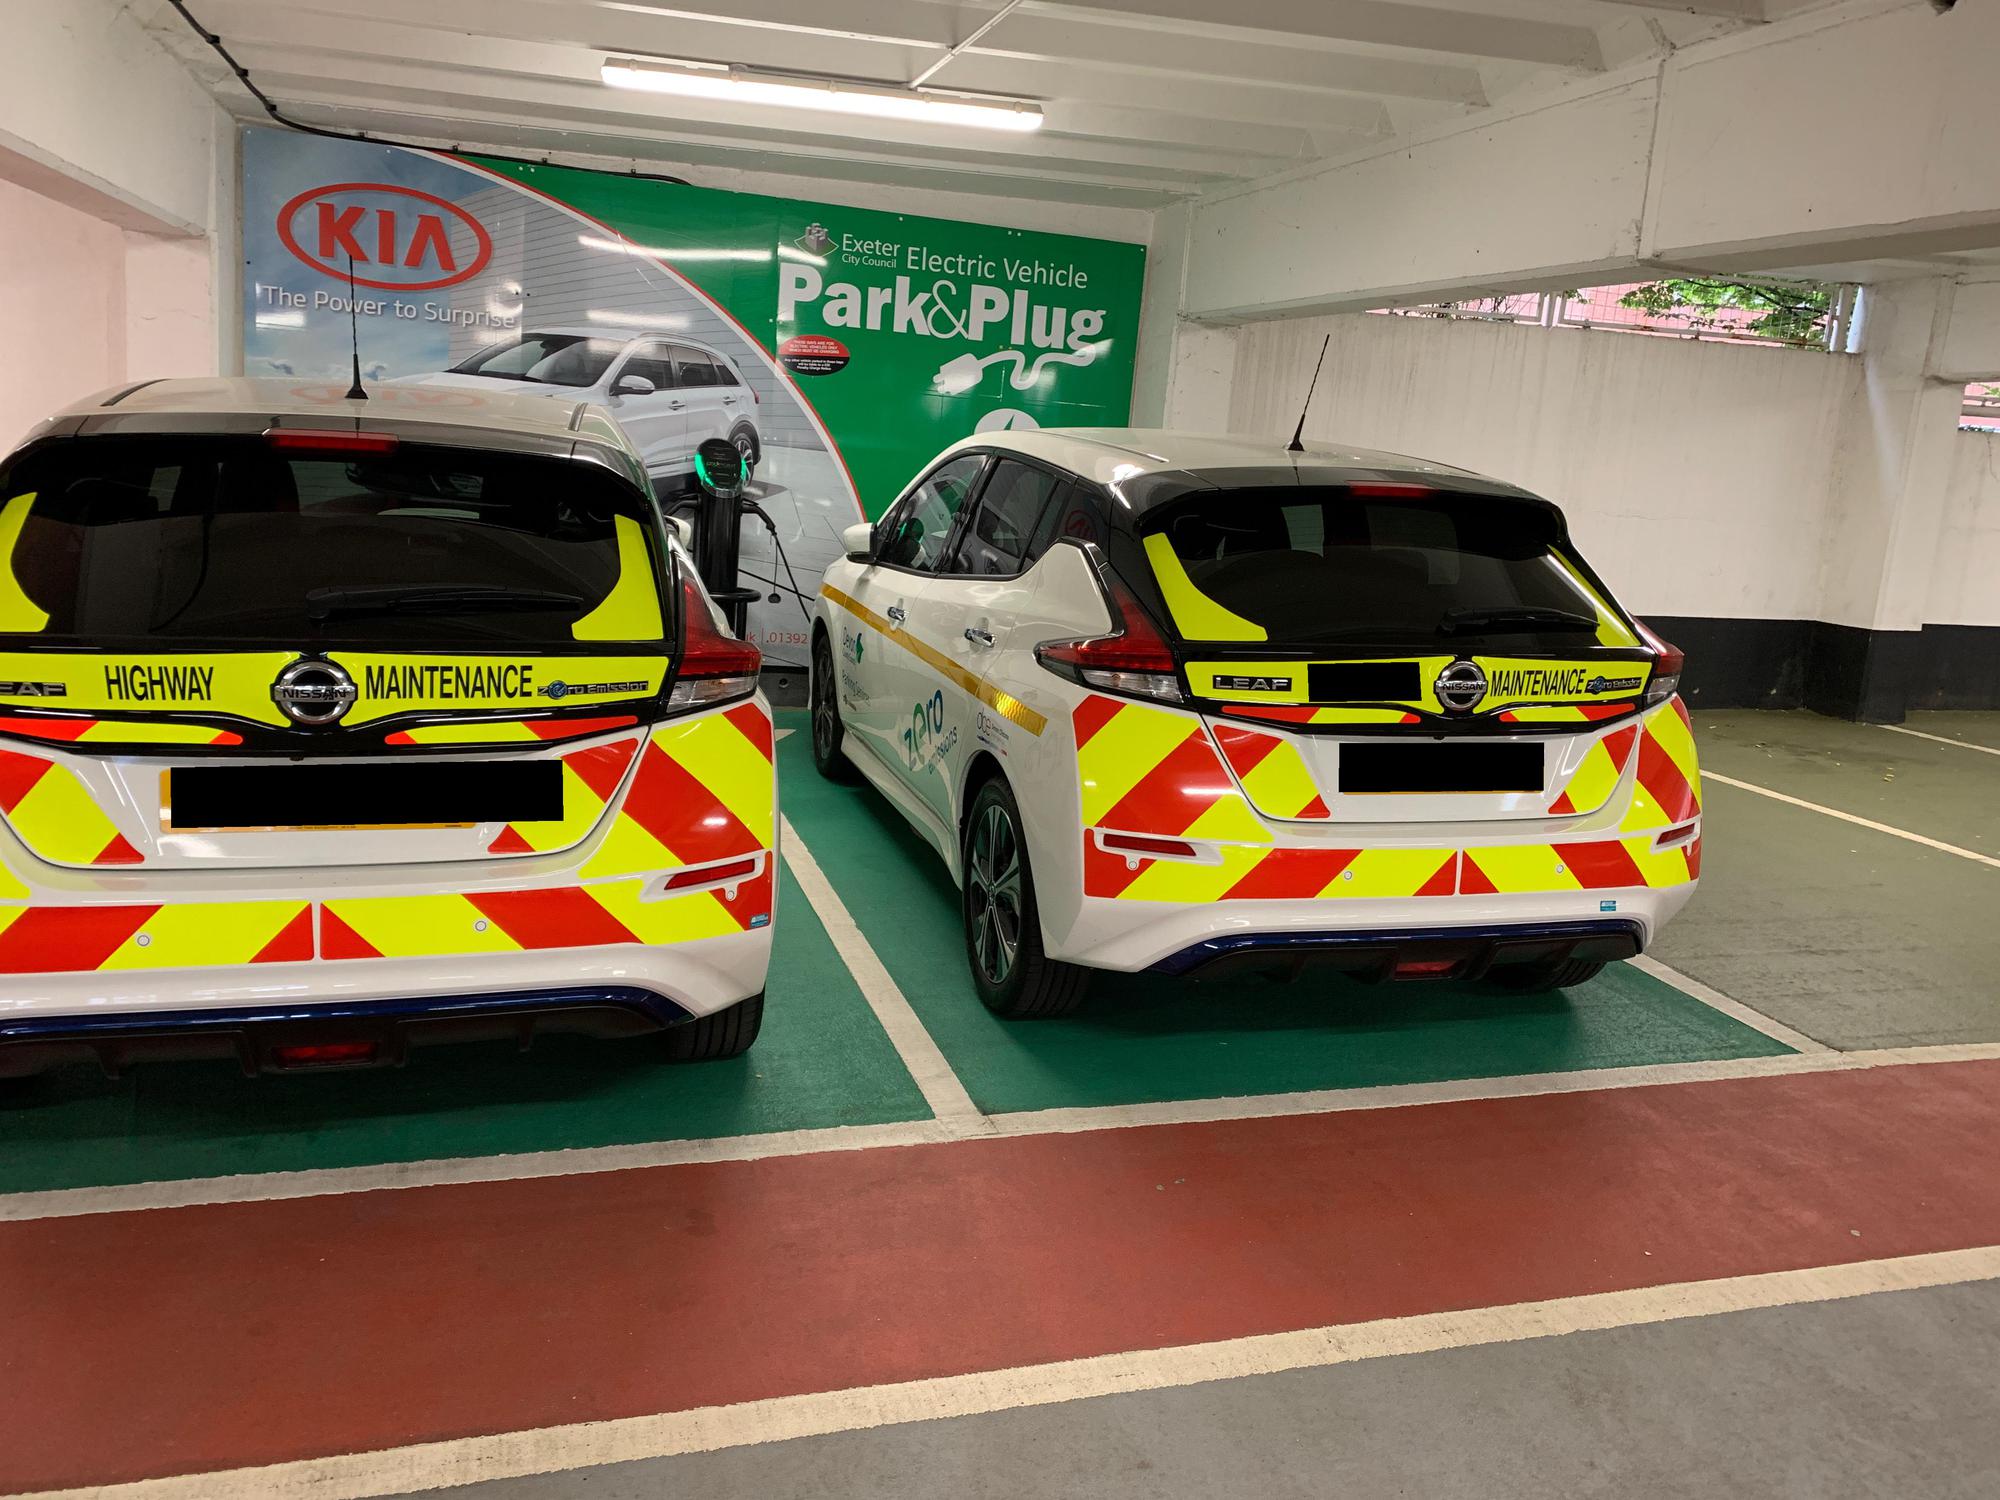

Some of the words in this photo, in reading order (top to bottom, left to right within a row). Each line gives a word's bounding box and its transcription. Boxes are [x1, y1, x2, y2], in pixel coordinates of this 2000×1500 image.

[316, 202, 457, 272] KIA
[842, 233, 901, 258] Exeter
[841, 254, 861, 268] City
[862, 256, 897, 269] Council
[906, 246, 997, 279] Electric
[1003, 257, 1089, 289] Vehicle
[263, 285, 307, 309] The
[315, 290, 387, 316] Power
[396, 300, 418, 319] to
[424, 302, 516, 329] Surprise
[104, 665, 214, 701] HIGHWAY
[365, 665, 533, 700] MAINTENANCE
[282, 687, 347, 700] NISSAN
[1215, 676, 1289, 690] LEAF
[1442, 683, 1484, 691] NISSAN
[1490, 668, 1586, 697] MAINTENANCE
[904, 689, 944, 772] zero
[928, 726, 958, 775] eissions
